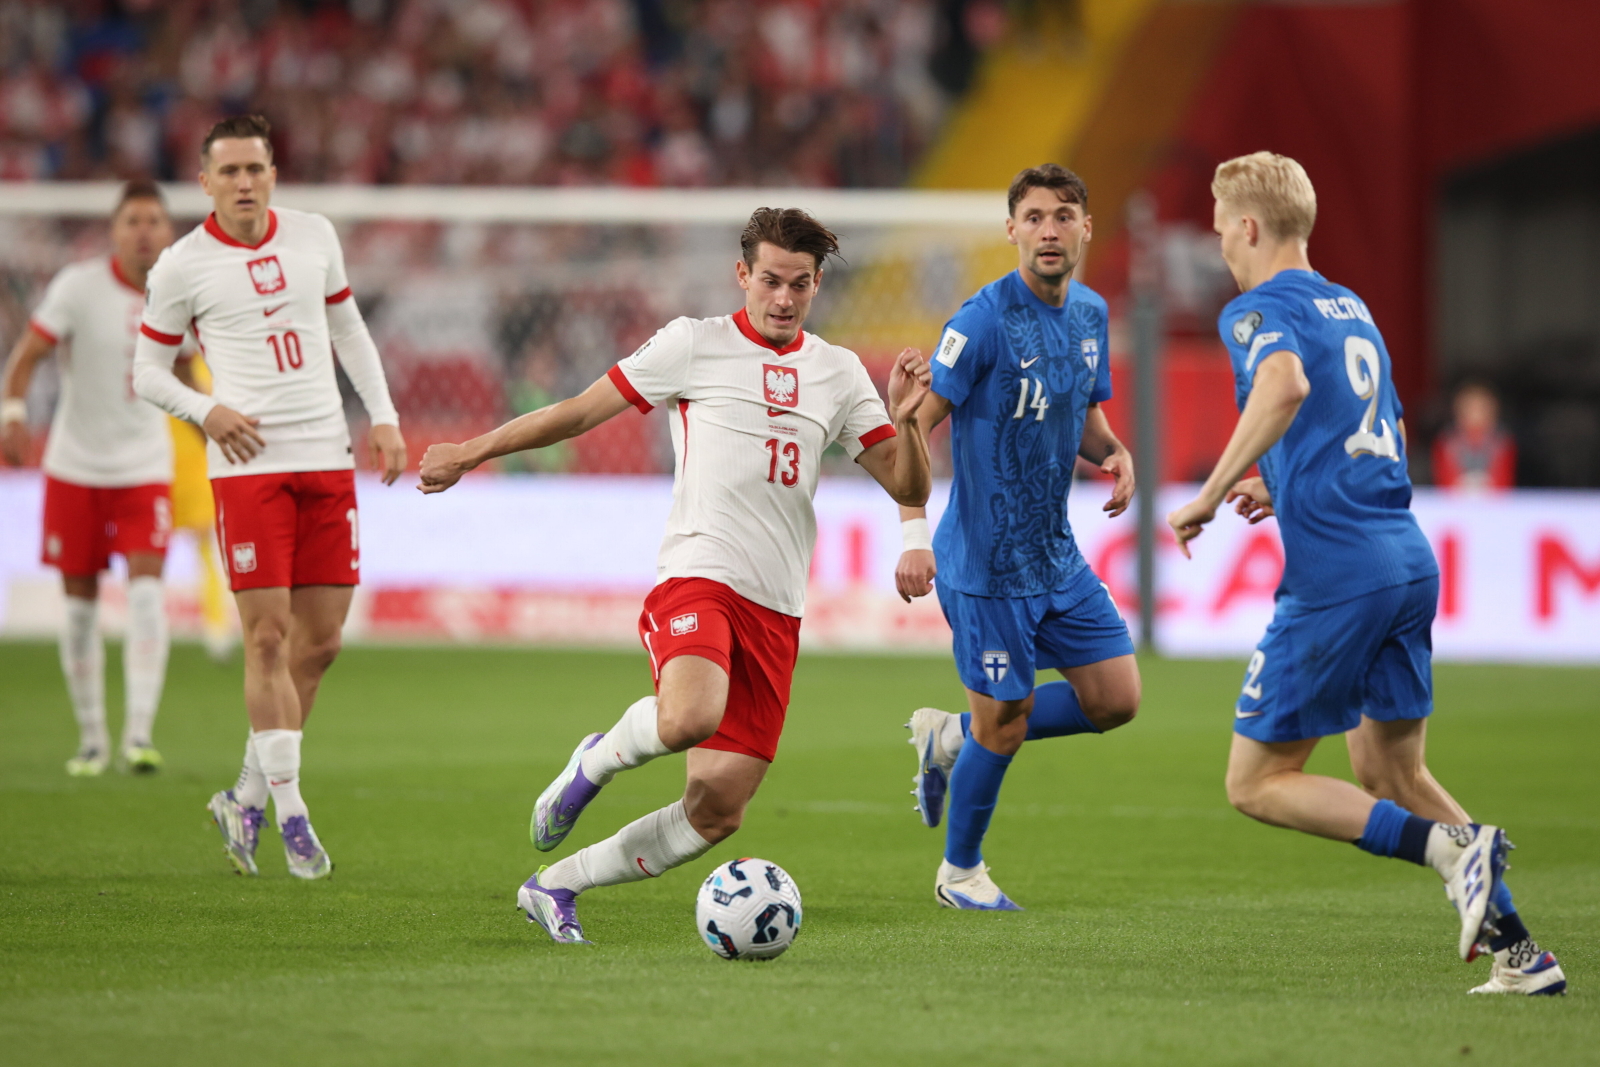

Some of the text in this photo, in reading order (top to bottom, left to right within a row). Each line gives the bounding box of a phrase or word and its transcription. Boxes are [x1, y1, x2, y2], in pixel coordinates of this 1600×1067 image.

[266, 331, 304, 373] 10
[1012, 377, 1050, 421] 14
[1344, 335, 1400, 461] 2
[765, 438, 800, 488] 13
[1242, 650, 1266, 700] 2
